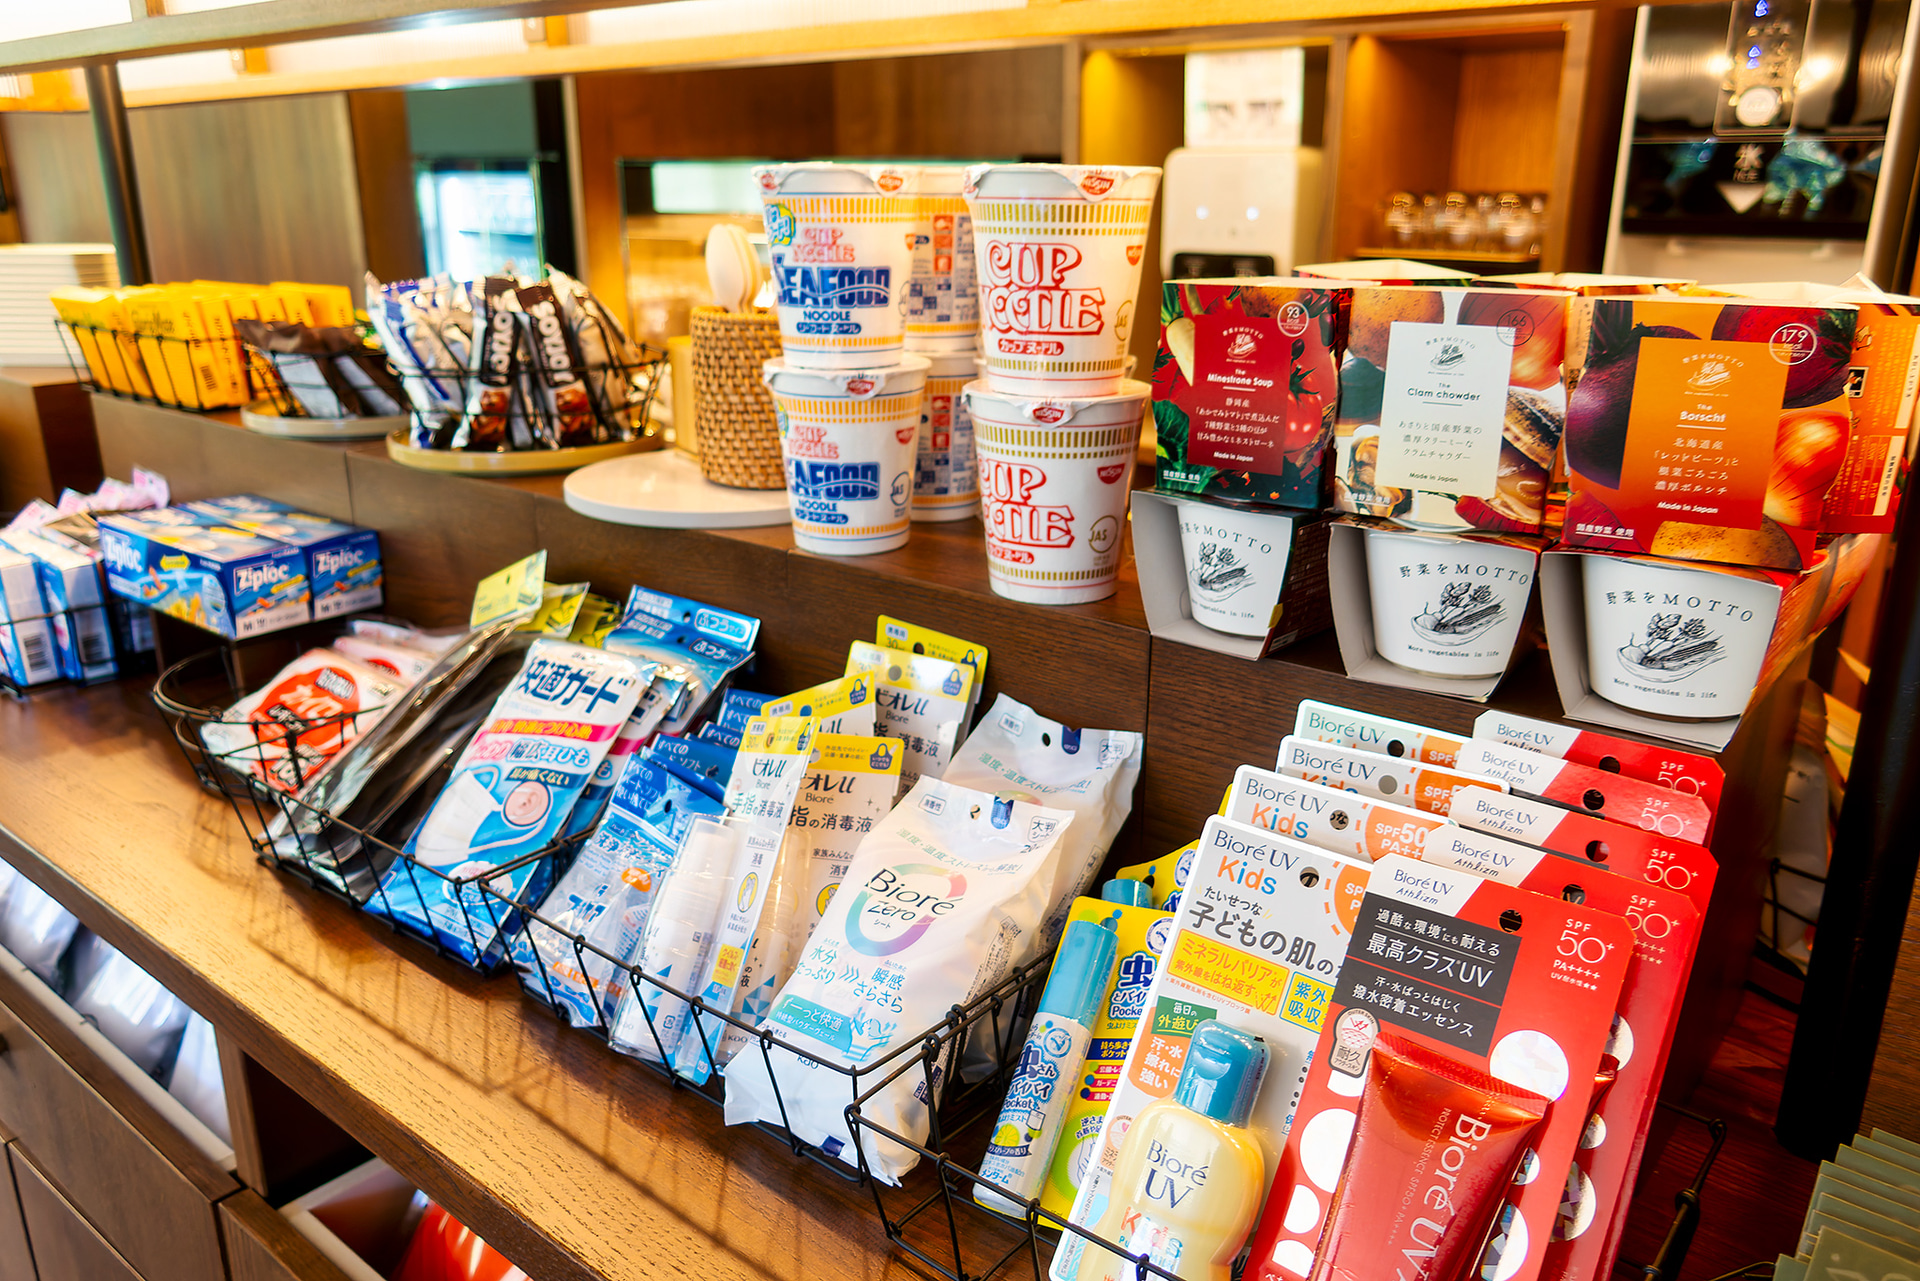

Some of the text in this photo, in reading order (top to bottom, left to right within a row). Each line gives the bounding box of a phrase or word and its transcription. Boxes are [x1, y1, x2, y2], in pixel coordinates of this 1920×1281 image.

[986, 240, 1082, 288] CUP
[803, 310, 850, 321] NOODLE
[1286, 306, 1300, 319] 93
[1506, 314, 1528, 328] 166
[1779, 328, 1808, 344] 179
[1000, 340, 1063, 356] カップ ヌードル
[1206, 373, 1274, 389] Minestrone Soup
[1407, 387, 1481, 401] Clam chowder
[1672, 438, 1723, 450] 北海道産
[1213, 451, 1229, 460] Made
[1235, 454, 1254, 463] Japan
[1409, 472, 1428, 481] Made
[1437, 475, 1459, 484] Japan
[1658, 466, 1729, 481] 根菜ごろごろ
[1654, 480, 1728, 497] 濃厚ボルシチ
[1657, 501, 1681, 512] Made
[1691, 504, 1718, 515] Japan
[1089, 528, 1107, 542] JAS
[315, 548, 364, 574] Ziploc
[235, 563, 289, 592] Ziploc
[1399, 562, 1530, 586] 野菜をMOTTO
[1606, 590, 1754, 622] 野菜をMOTTO
[1427, 648, 1470, 659] vegetables
[1486, 650, 1500, 658] life
[1613, 677, 1630, 689] More
[1633, 683, 1681, 698] vegetables
[1700, 690, 1718, 700] life
[706, 729, 740, 747] すべての
[1309, 712, 1355, 737] Bioré
[1359, 726, 1386, 744] UV
[1497, 723, 1555, 746] Bioré UV
[658, 740, 689, 755] すべての
[1292, 748, 1376, 780] Bioré UV
[1481, 751, 1539, 777] Bioré UV
[1661, 760, 1684, 772] SPF
[510, 768, 570, 785] 耳が痛くない
[1484, 767, 1525, 786] Athlizm
[805, 793, 834, 805] Bioré
[1245, 778, 1297, 806] Bioré
[1300, 794, 1329, 814] UV
[1645, 797, 1670, 810] SPF
[1251, 803, 1309, 839] Kids
[1476, 800, 1538, 827] Bioré UV
[1638, 807, 1692, 838] 50+
[1031, 830, 1050, 840] シート
[1032, 819, 1056, 833] 大判
[1479, 817, 1524, 836] Athlizm
[1214, 829, 1300, 871] Bioré UV
[1451, 839, 1515, 869] Bioré UV
[1651, 848, 1676, 861] SPF
[1217, 855, 1277, 896] Kids
[1453, 857, 1499, 878] Athlizm
[1643, 858, 1699, 890] 50+
[864, 868, 965, 916] Bioré
[1393, 868, 1454, 896] Bioré UV
[1204, 886, 1263, 917] たいせつな
[1395, 886, 1439, 906] Athlizm
[1630, 894, 1656, 908] SPF
[873, 919, 892, 930] シート
[1565, 918, 1592, 932] SPF
[1189, 900, 1342, 978] 子どもの肌の
[1556, 930, 1615, 965] 50+
[809, 945, 839, 965] 水分
[1181, 936, 1283, 989] ミネラルバリアが
[872, 966, 906, 989] 瞬感
[1174, 959, 1255, 997] 紫外線をはね返す
[1553, 959, 1601, 980] PA++++
[852, 980, 904, 1014] さらさら
[1112, 1005, 1142, 1017] Pocke
[1173, 1001, 1198, 1016] 毎日の
[1352, 983, 1475, 1038] 撥水密着エッセンス
[1157, 1013, 1200, 1030] 外遊び
[1151, 1037, 1184, 1060] 汗・水
[1338, 1046, 1361, 1066] 耐久
[1143, 1054, 1181, 1078] 擦れに
[1139, 1067, 1169, 1089] 強い
[1429, 1107, 1452, 1140] PROTECT
[1147, 1139, 1210, 1186] Bioré
[1414, 1140, 1437, 1175] ESSENCE
[1145, 1167, 1194, 1209] UV
[1401, 1113, 1492, 1281] Bioré UV
